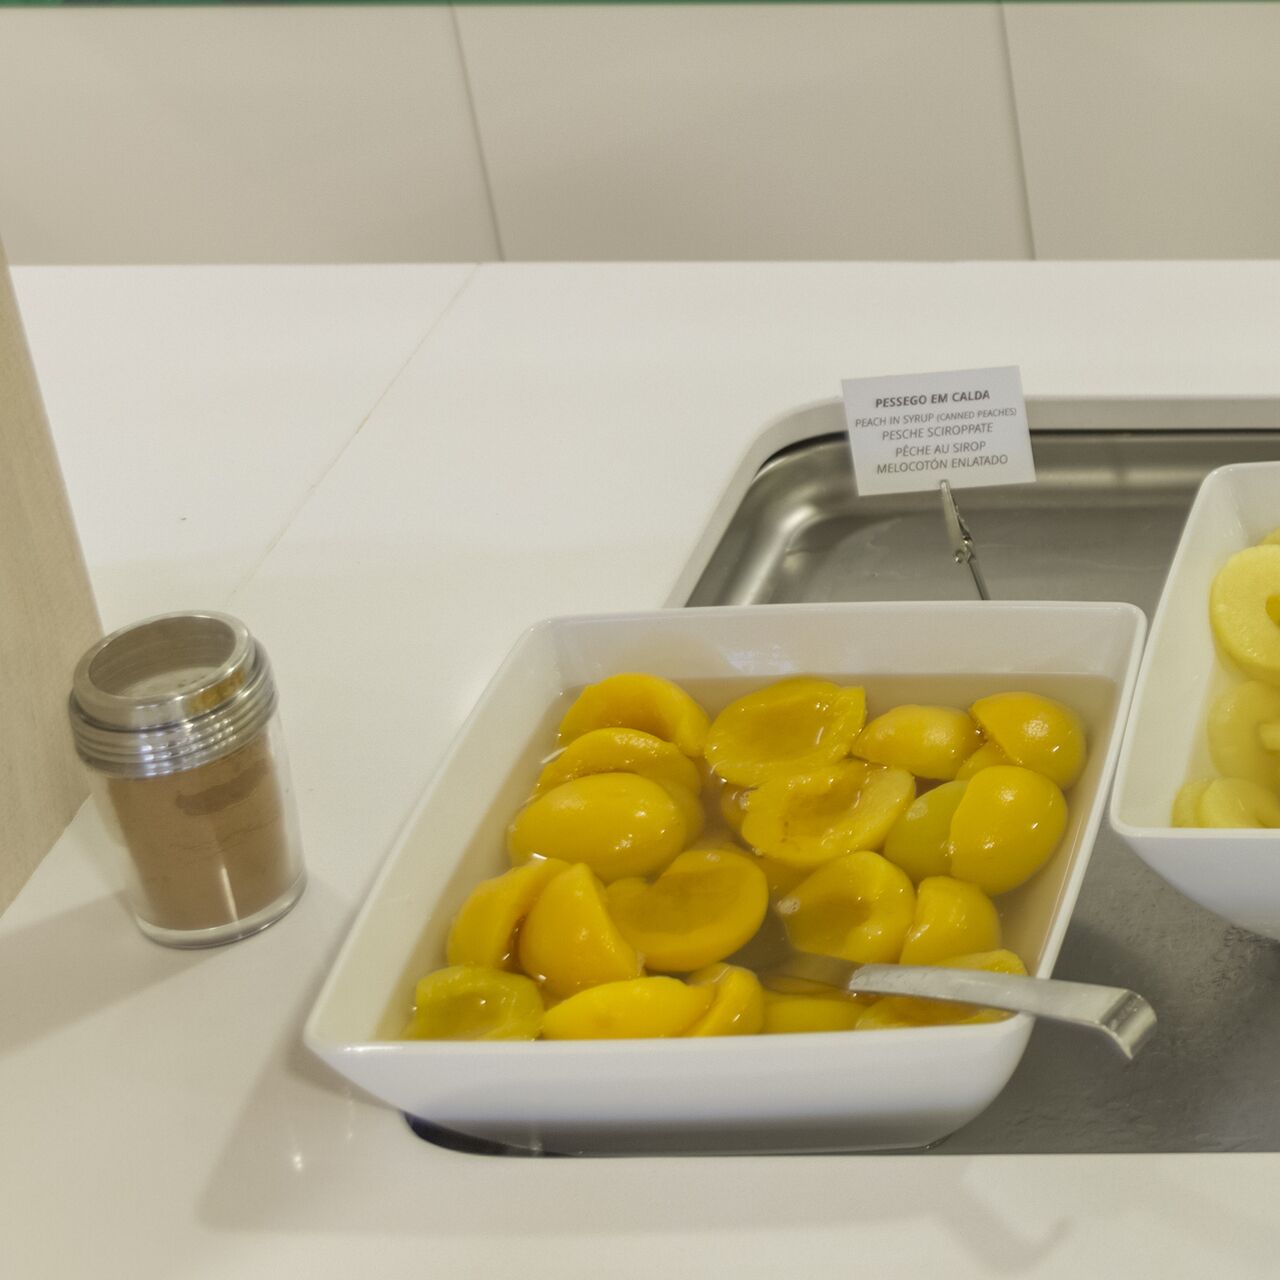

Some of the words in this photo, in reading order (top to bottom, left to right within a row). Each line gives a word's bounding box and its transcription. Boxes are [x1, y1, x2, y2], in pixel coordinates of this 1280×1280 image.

[875, 395, 927, 408] PESSEGO
[931, 393, 948, 404] EM
[952, 390, 990, 402] CALDA
[855, 417, 886, 428] PEACH
[890, 416, 900, 425] IN
[903, 413, 934, 424] SYRUP
[936, 411, 975, 423] (CANNED
[977, 407, 1017, 419] PEACHES)
[882, 429, 924, 440] PESCHE
[928, 423, 993, 437] SCIROPPATE
[895, 443, 931, 457] PÊCHE
[935, 444, 950, 454] AU
[953, 441, 986, 453] SIROP
[876, 459, 948, 474] MELOCOTÓN
[951, 454, 1008, 468] ENLATADO
